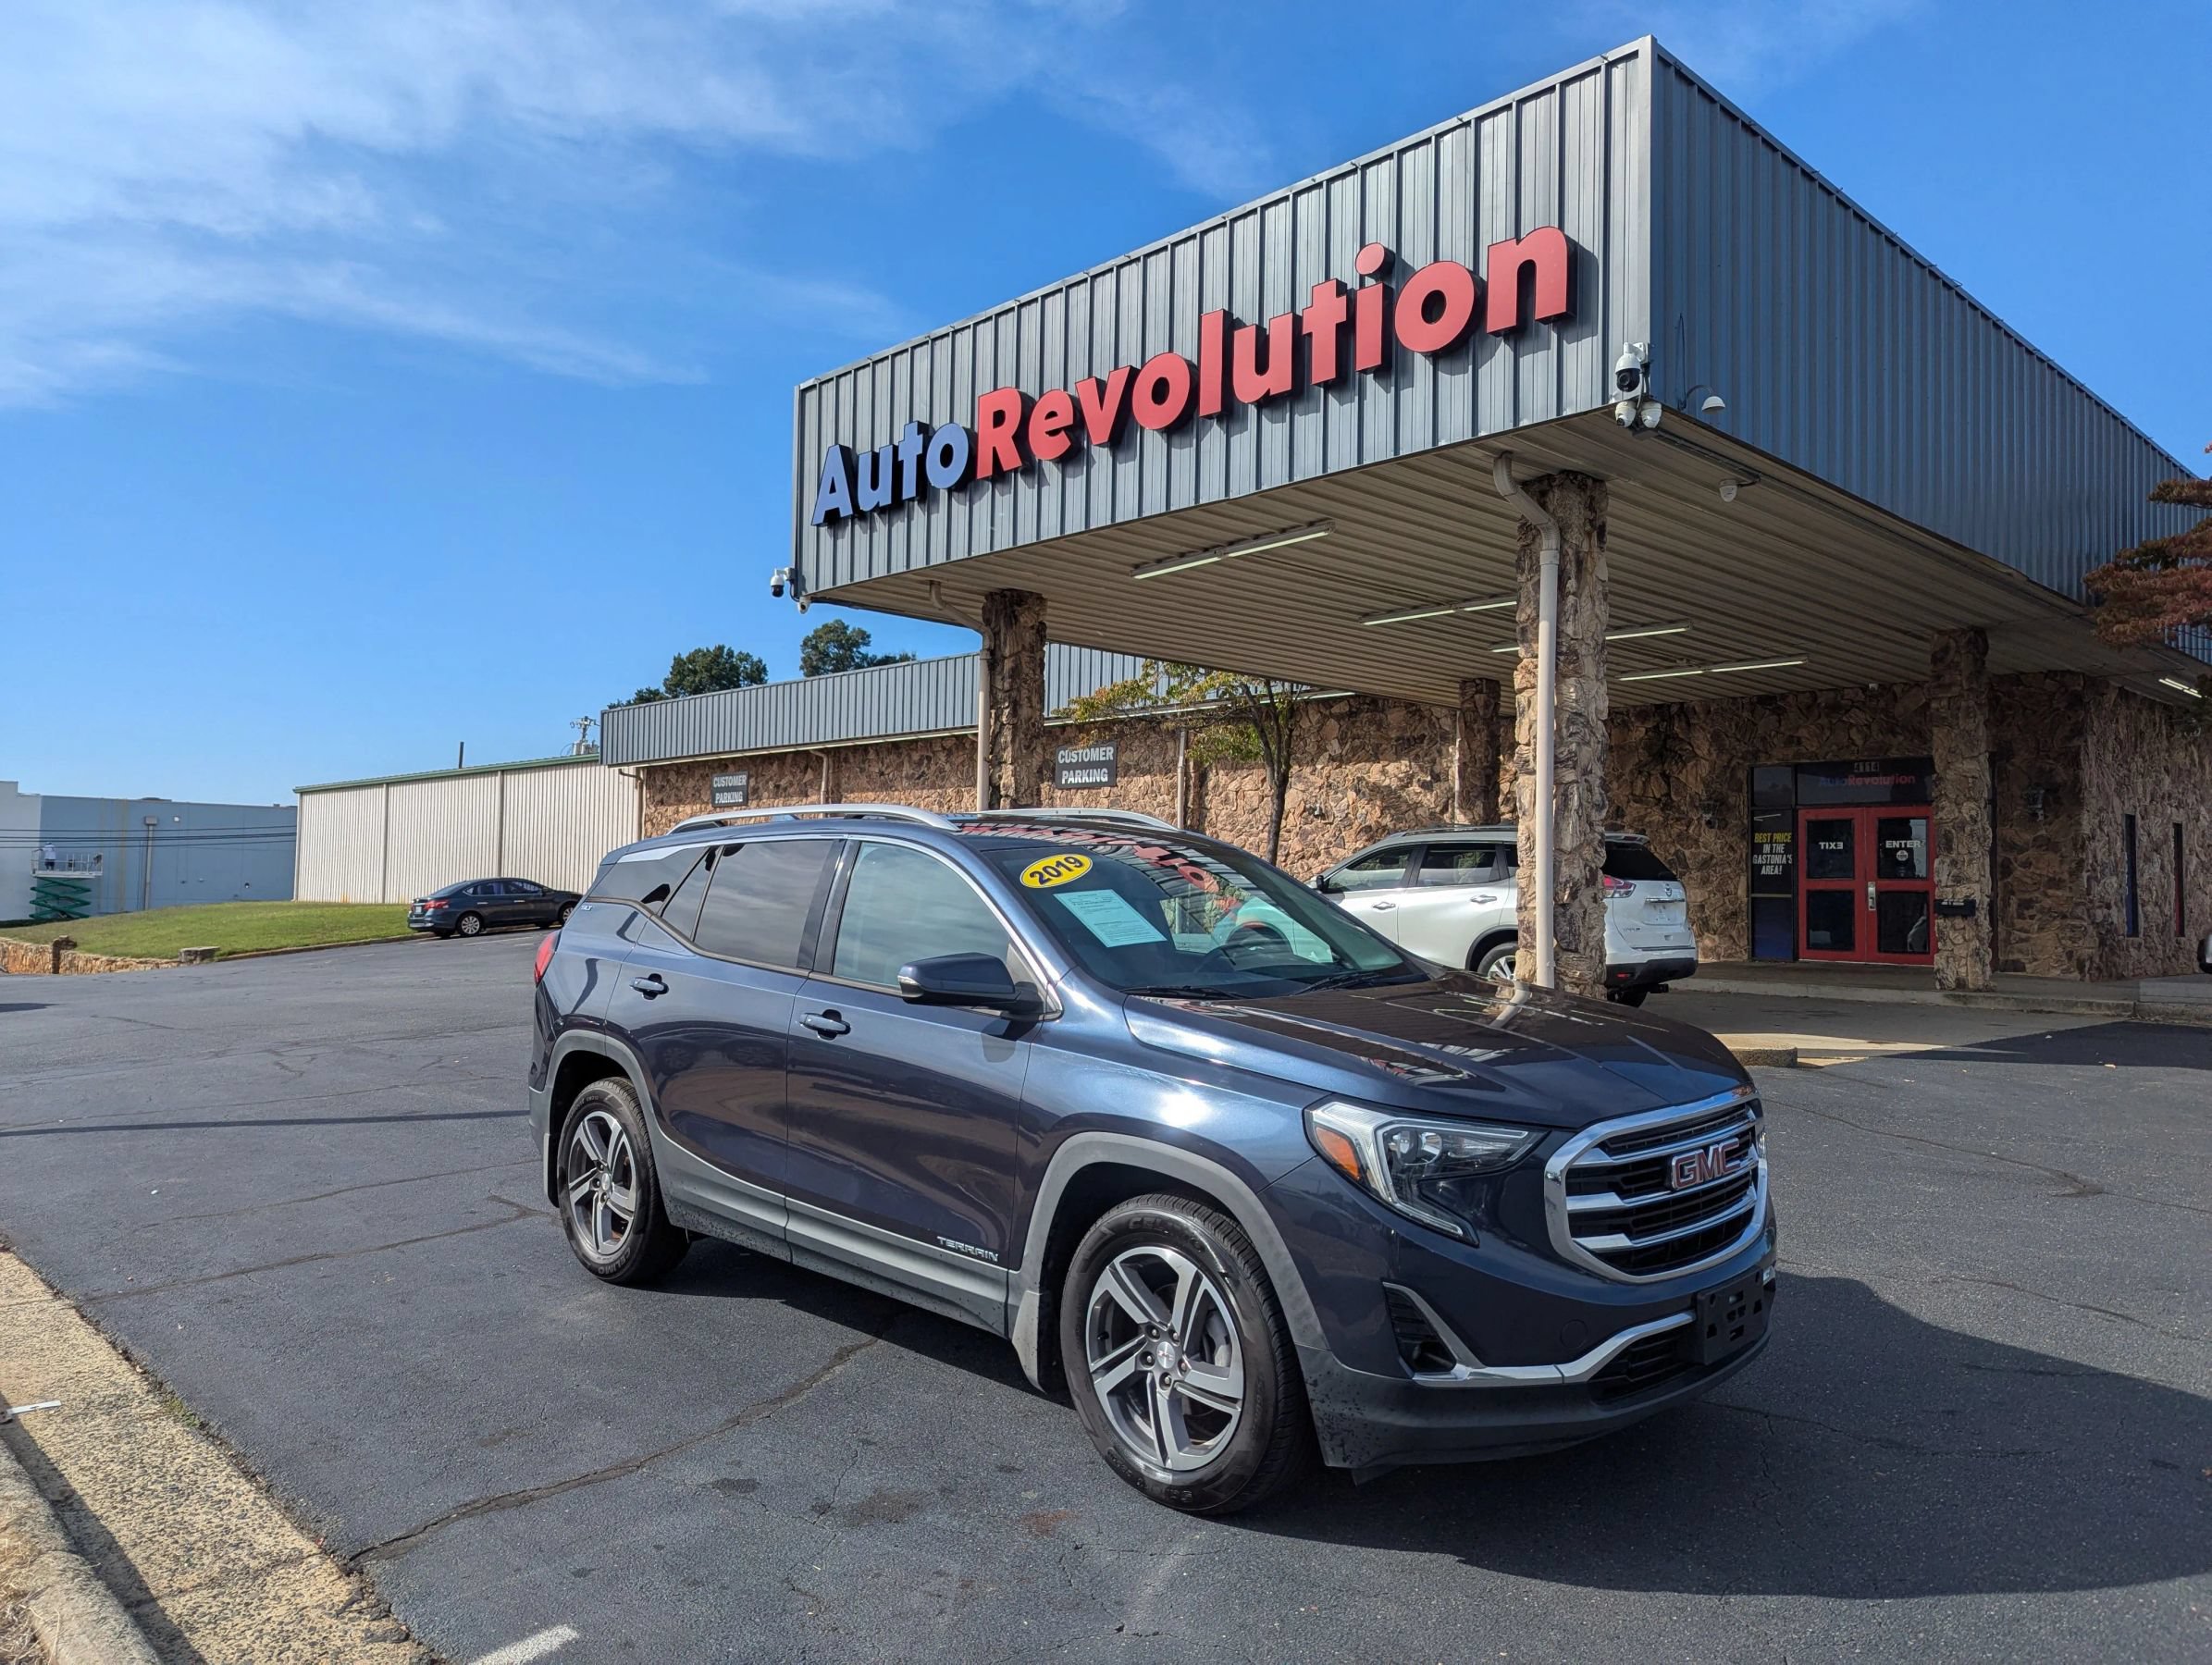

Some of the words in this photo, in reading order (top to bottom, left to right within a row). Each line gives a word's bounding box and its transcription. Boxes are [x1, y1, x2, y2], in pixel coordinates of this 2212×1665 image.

[1057, 746, 1114, 764] CUSTOMER
[713, 774, 747, 787] CUSTOMER
[1061, 768, 1108, 784] PARKING
[715, 791, 743, 804] PARKING
[1754, 832, 1772, 843] BEST
[1773, 832, 1792, 843] PRICE
[1885, 840, 1922, 848] ENTER
[1762, 843, 1771, 853] IN
[1772, 844, 1786, 854] THE
[1752, 854, 1793, 865] GASTONIA'S
[1029, 856, 1084, 885] 2019
[1672, 1137, 1740, 1190] GMC
[937, 1236, 999, 1262] TERRAIN
